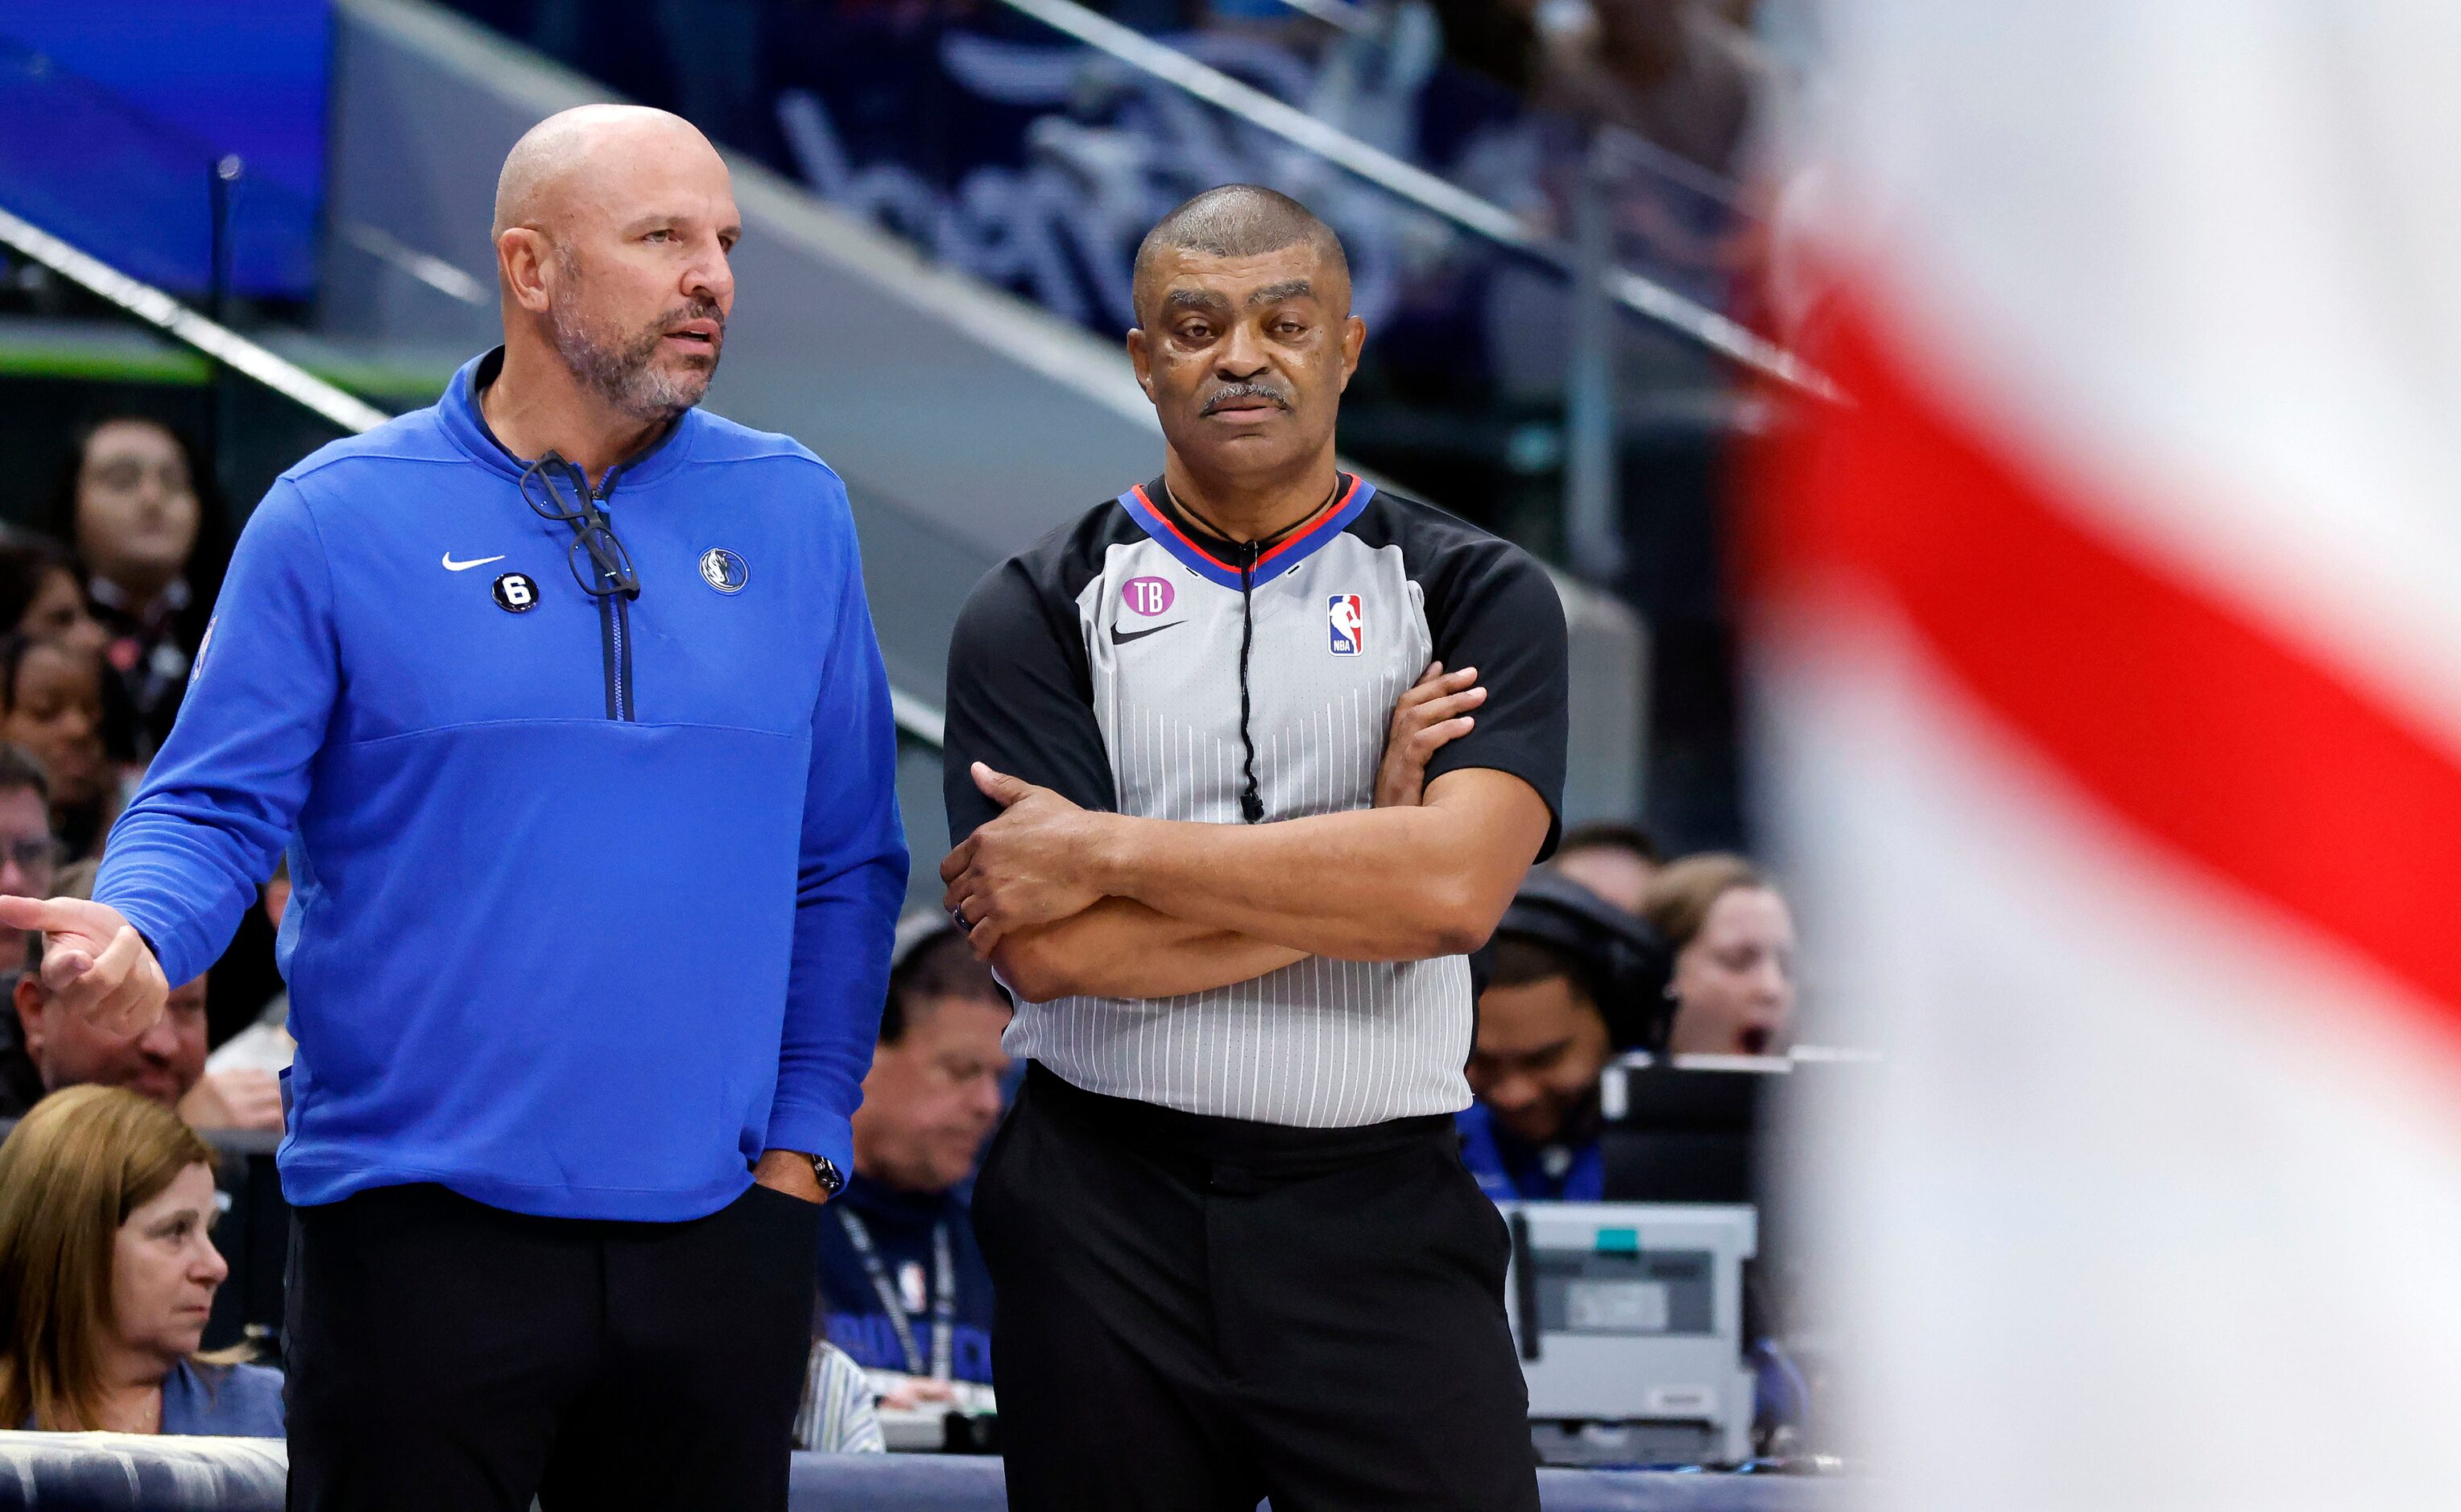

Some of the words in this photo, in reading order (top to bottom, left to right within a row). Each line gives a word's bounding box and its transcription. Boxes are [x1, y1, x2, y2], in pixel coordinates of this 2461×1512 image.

[502, 576, 531, 605] 6
[1133, 581, 1164, 613] TB
[1333, 639, 1350, 651] NBA
